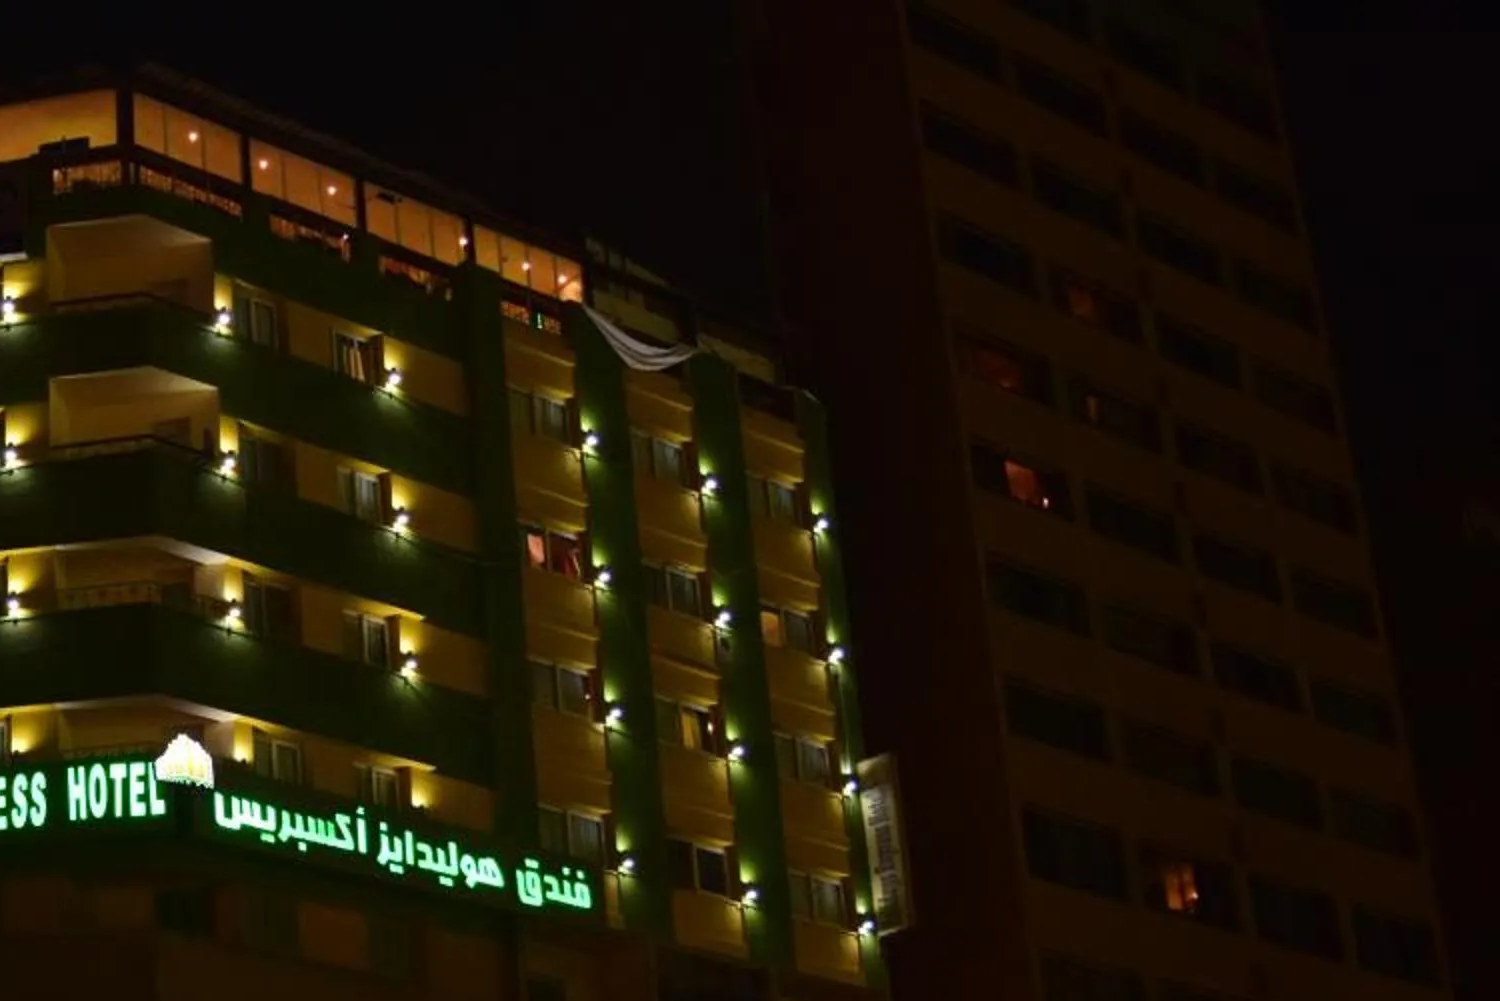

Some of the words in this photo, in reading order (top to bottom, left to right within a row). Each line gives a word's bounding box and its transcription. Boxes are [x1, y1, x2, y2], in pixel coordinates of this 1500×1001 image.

[67, 761, 166, 822] HOTEL
[214, 792, 368, 854] أكسبريس
[377, 821, 505, 889] هوليدايز
[515, 858, 593, 910] فندق
